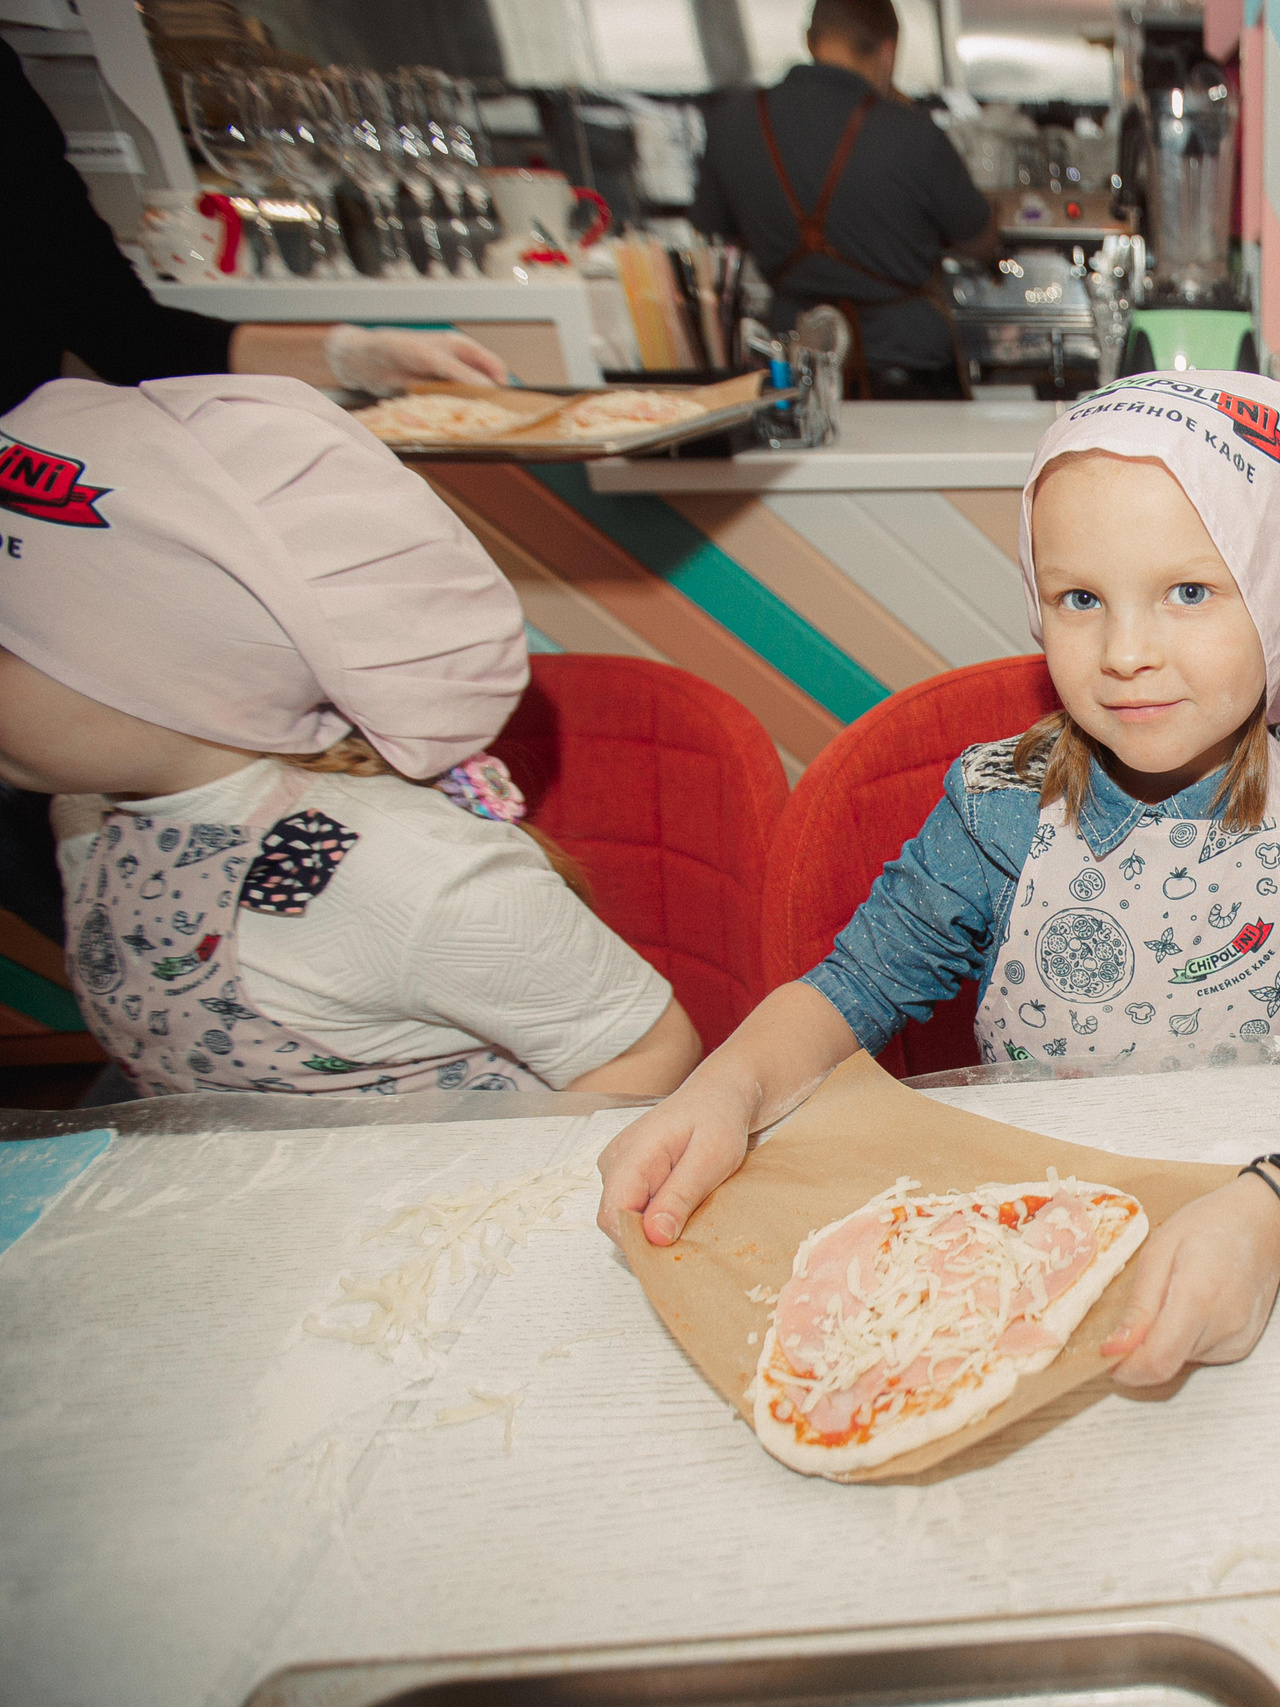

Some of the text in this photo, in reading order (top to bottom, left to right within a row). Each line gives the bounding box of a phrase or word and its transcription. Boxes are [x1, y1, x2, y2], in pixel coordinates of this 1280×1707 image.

[1069, 401, 1256, 484] СЕМЕЙНОЕ КАФЕ
[1197, 949, 1275, 997] СЕМЕЙНОЕ КАФЕ
